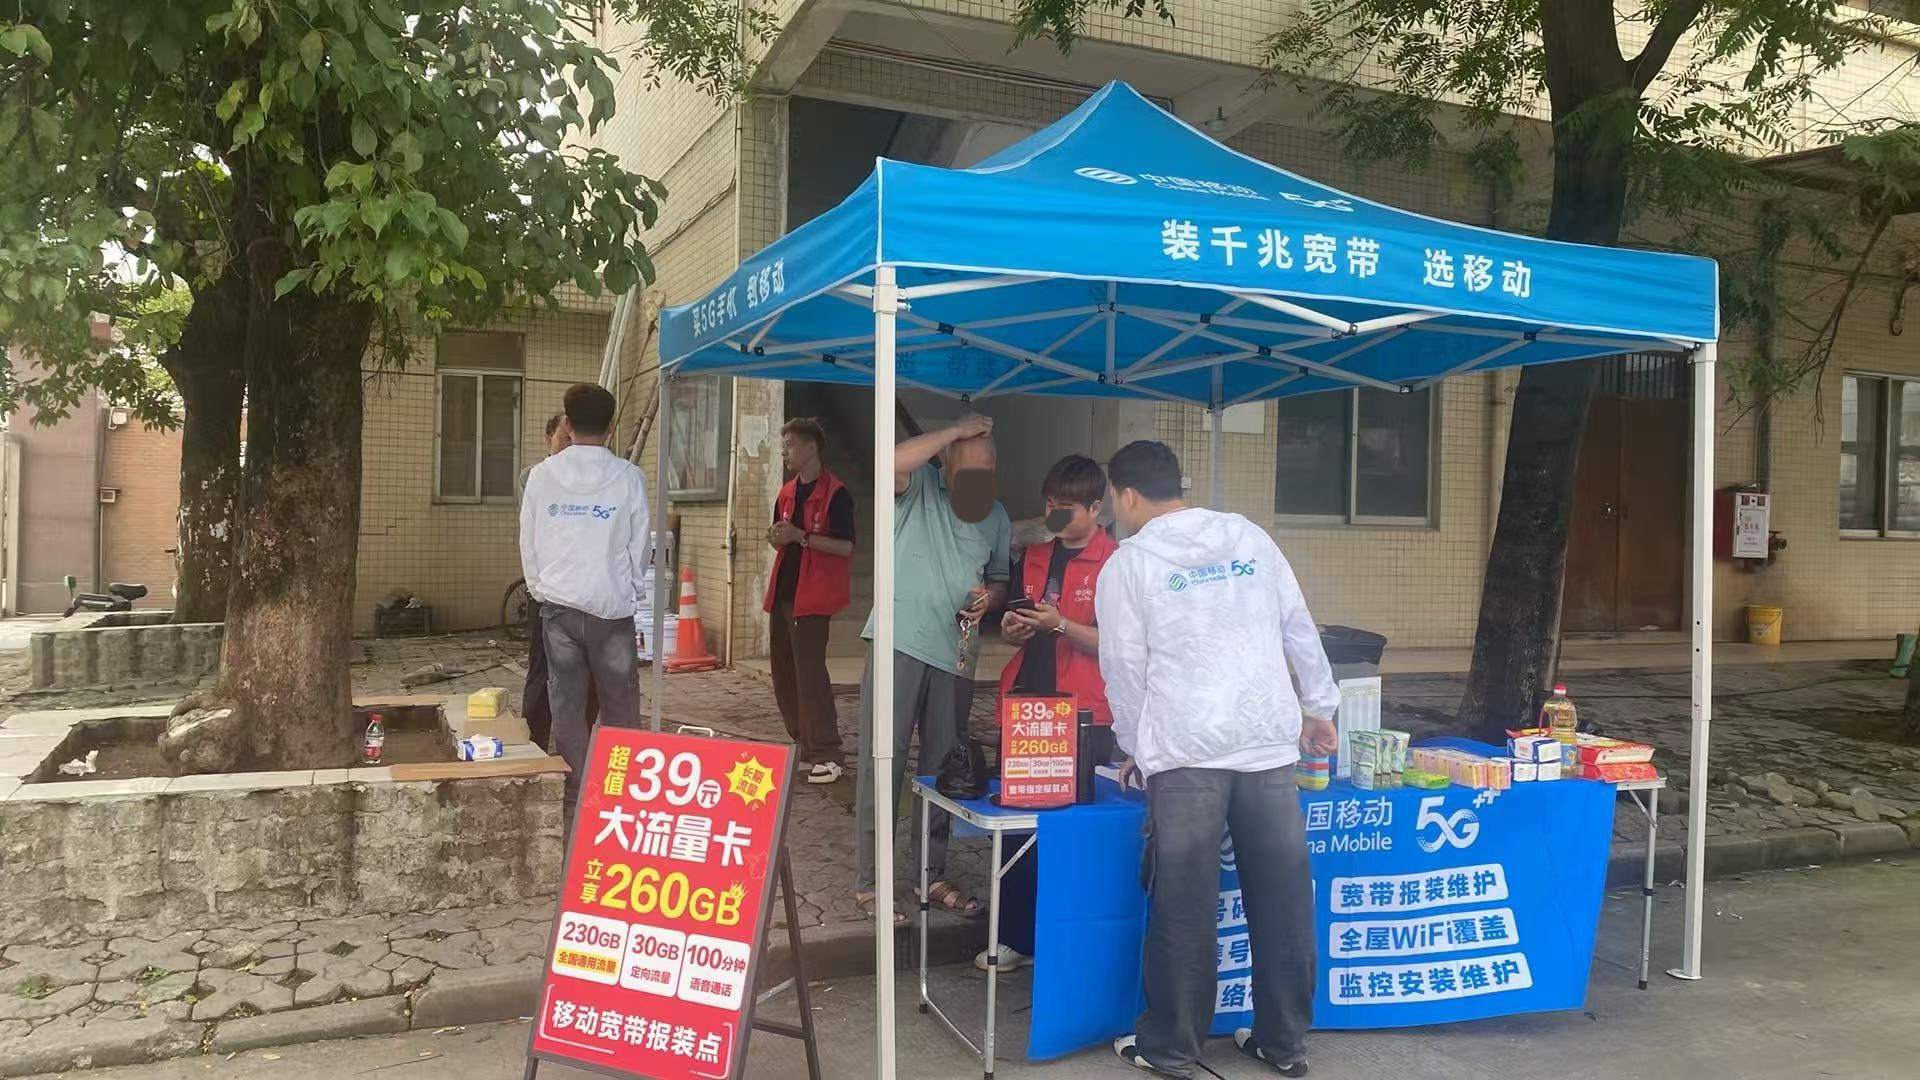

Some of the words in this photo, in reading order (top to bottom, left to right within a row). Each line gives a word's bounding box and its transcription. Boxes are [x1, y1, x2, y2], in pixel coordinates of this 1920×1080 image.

[1160, 218, 1381, 279] 装千兆宽带
[1422, 248, 1532, 299] 选移动
[603, 745, 631, 797] 超值
[1305, 796, 1392, 831] 国移动
[594, 805, 752, 866] 大流量卡
[1331, 831, 1392, 852] Mobile
[580, 859, 602, 904] 立享
[600, 863, 742, 926] 260GB
[1340, 869, 1497, 908] 宽带报装维护
[562, 921, 621, 949] 230GB
[631, 934, 680, 961] 30GB
[1339, 914, 1509, 953] 全屋WiFi覆盖
[558, 952, 617, 974] 全国通用流量
[630, 966, 671, 985] 定向流量
[687, 944, 746, 974] 100分钟
[690, 977, 733, 998] 语音通话
[1338, 959, 1520, 999] 监控安装维护
[551, 999, 723, 1064] 移动宽带报装点
